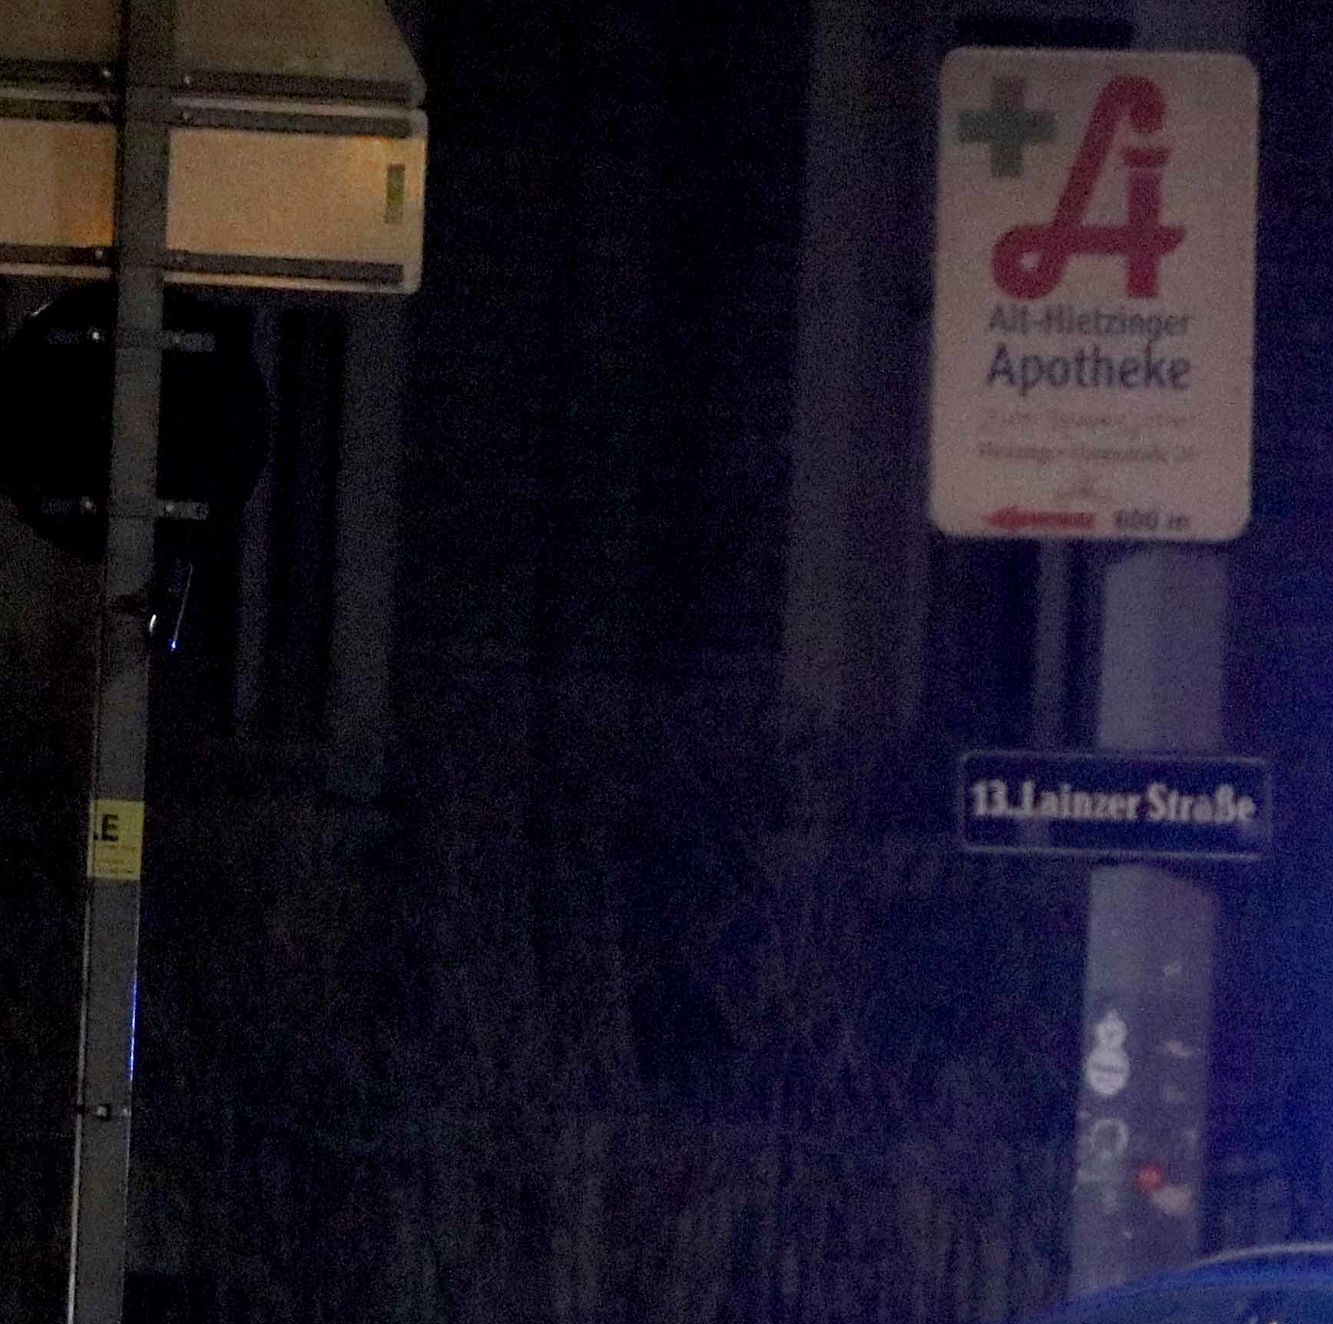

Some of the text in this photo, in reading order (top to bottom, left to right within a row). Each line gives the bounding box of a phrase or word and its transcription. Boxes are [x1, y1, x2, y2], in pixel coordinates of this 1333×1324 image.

[988, 305, 1192, 342] Alt-Hietzinger
[987, 342, 1192, 396] Apotheke
[1145, 781, 1257, 823] Straße
